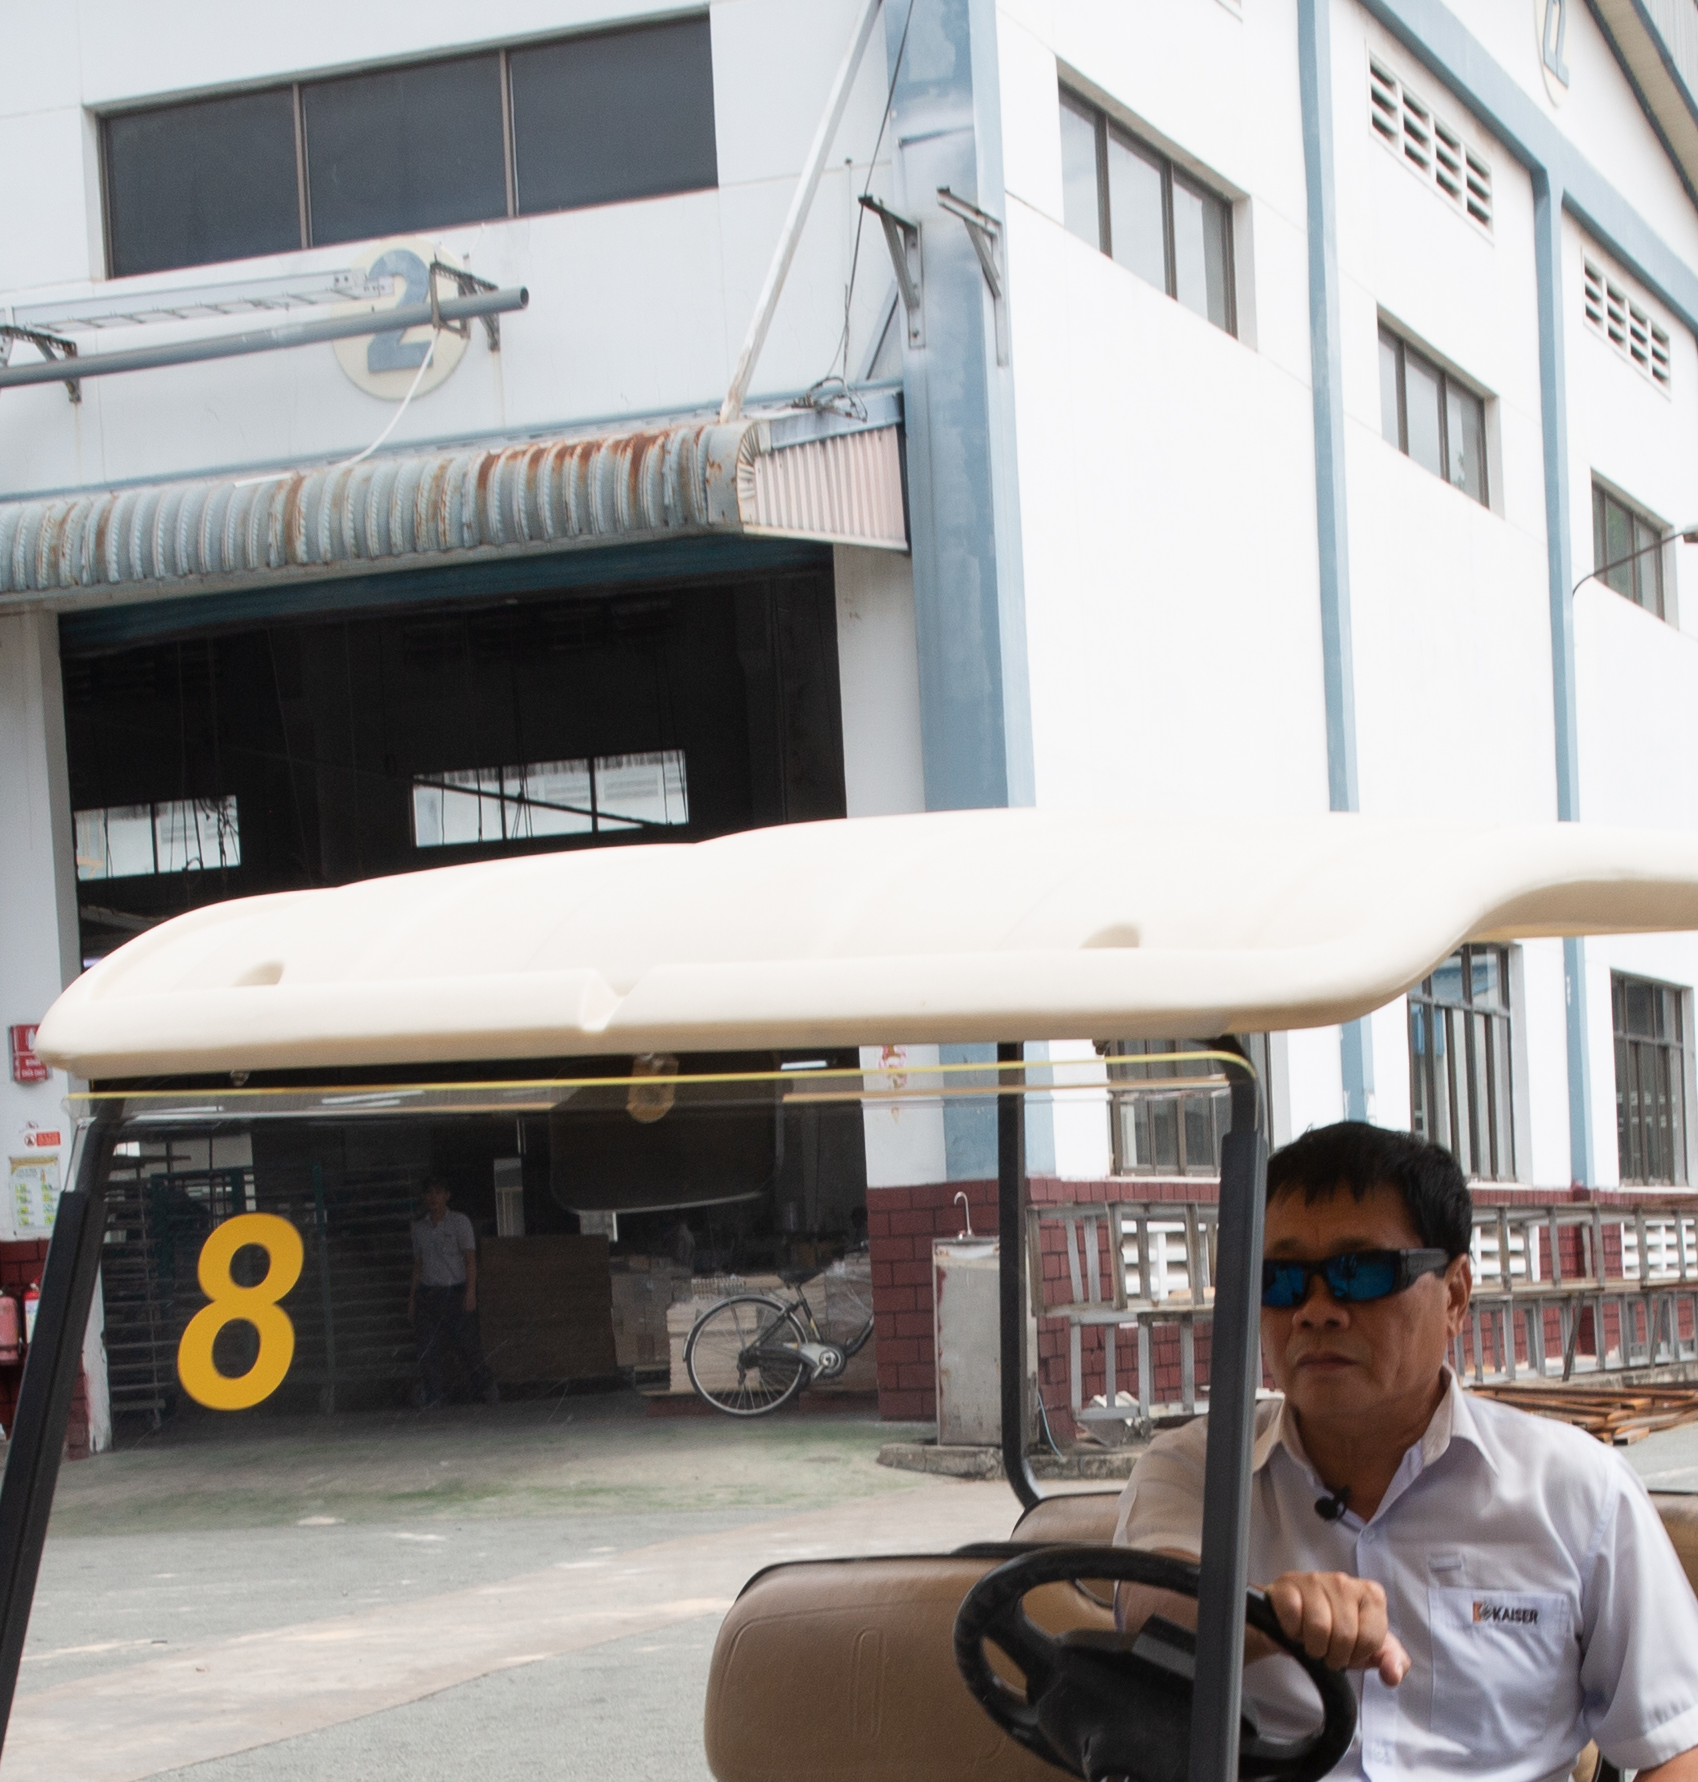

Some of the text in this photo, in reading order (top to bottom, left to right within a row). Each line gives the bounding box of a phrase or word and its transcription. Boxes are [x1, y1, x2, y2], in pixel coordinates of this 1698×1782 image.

[367, 248, 433, 374] 2
[177, 1212, 305, 1411] 8
[1492, 1605, 1539, 1625] KAISER
